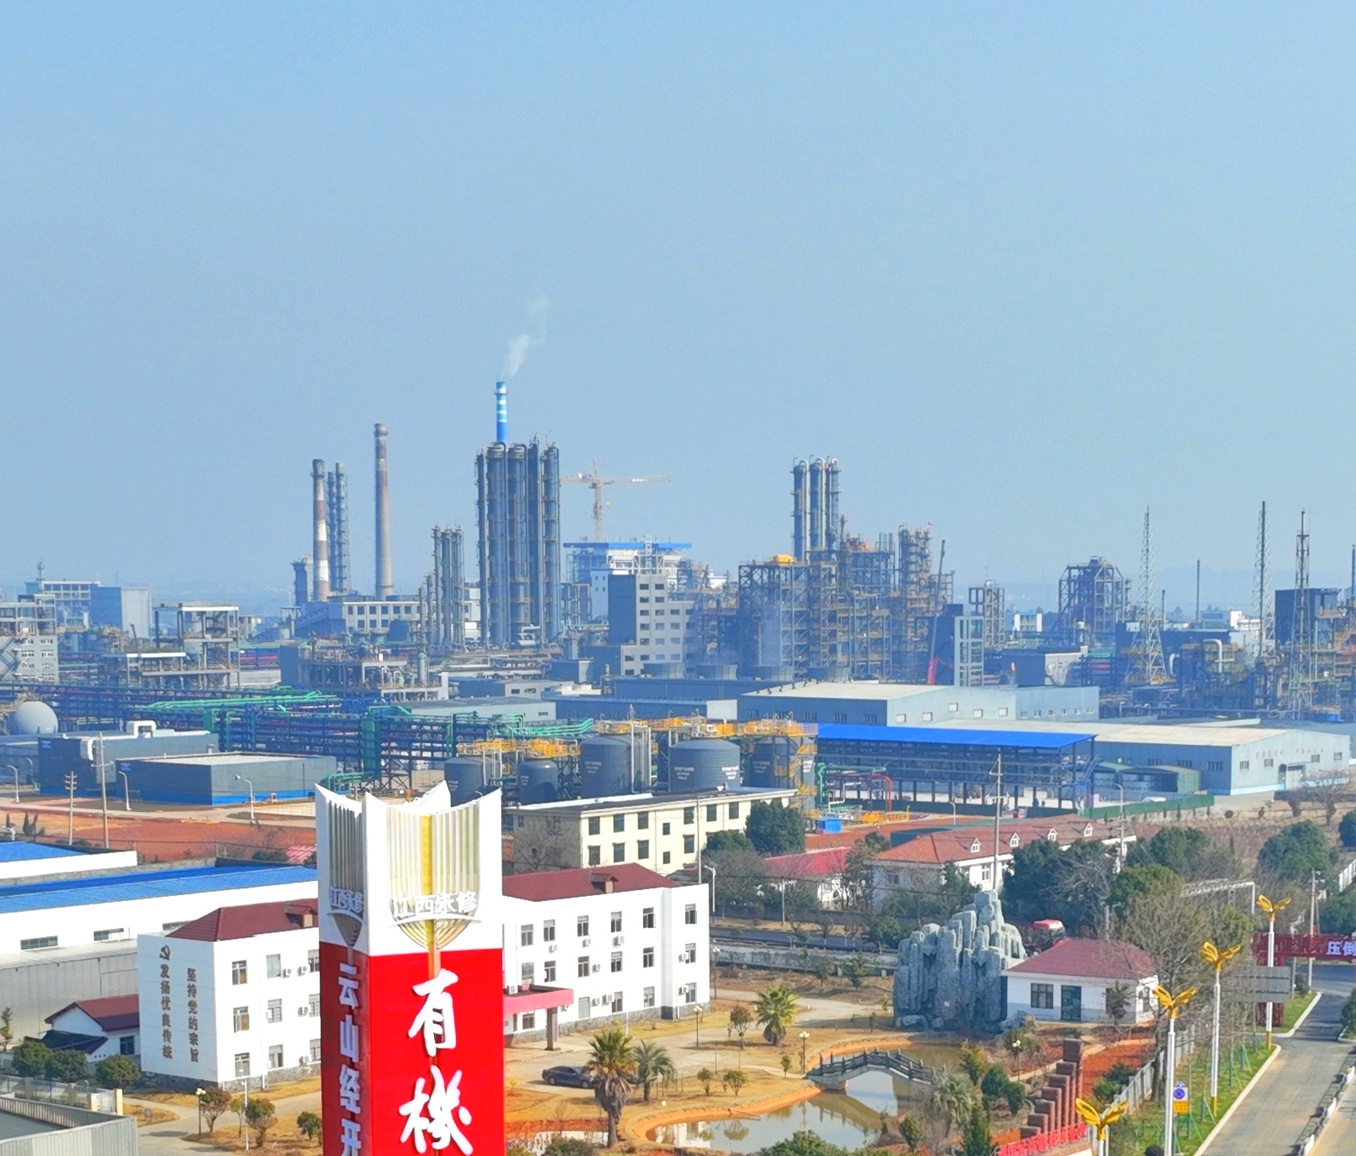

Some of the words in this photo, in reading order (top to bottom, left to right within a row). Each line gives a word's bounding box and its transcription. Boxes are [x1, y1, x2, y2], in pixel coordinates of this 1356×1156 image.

[391, 891, 477, 917] 江西永修
[160, 963, 173, 1060] 发扬优良传统
[187, 967, 199, 1063] 坚持党的宗旨
